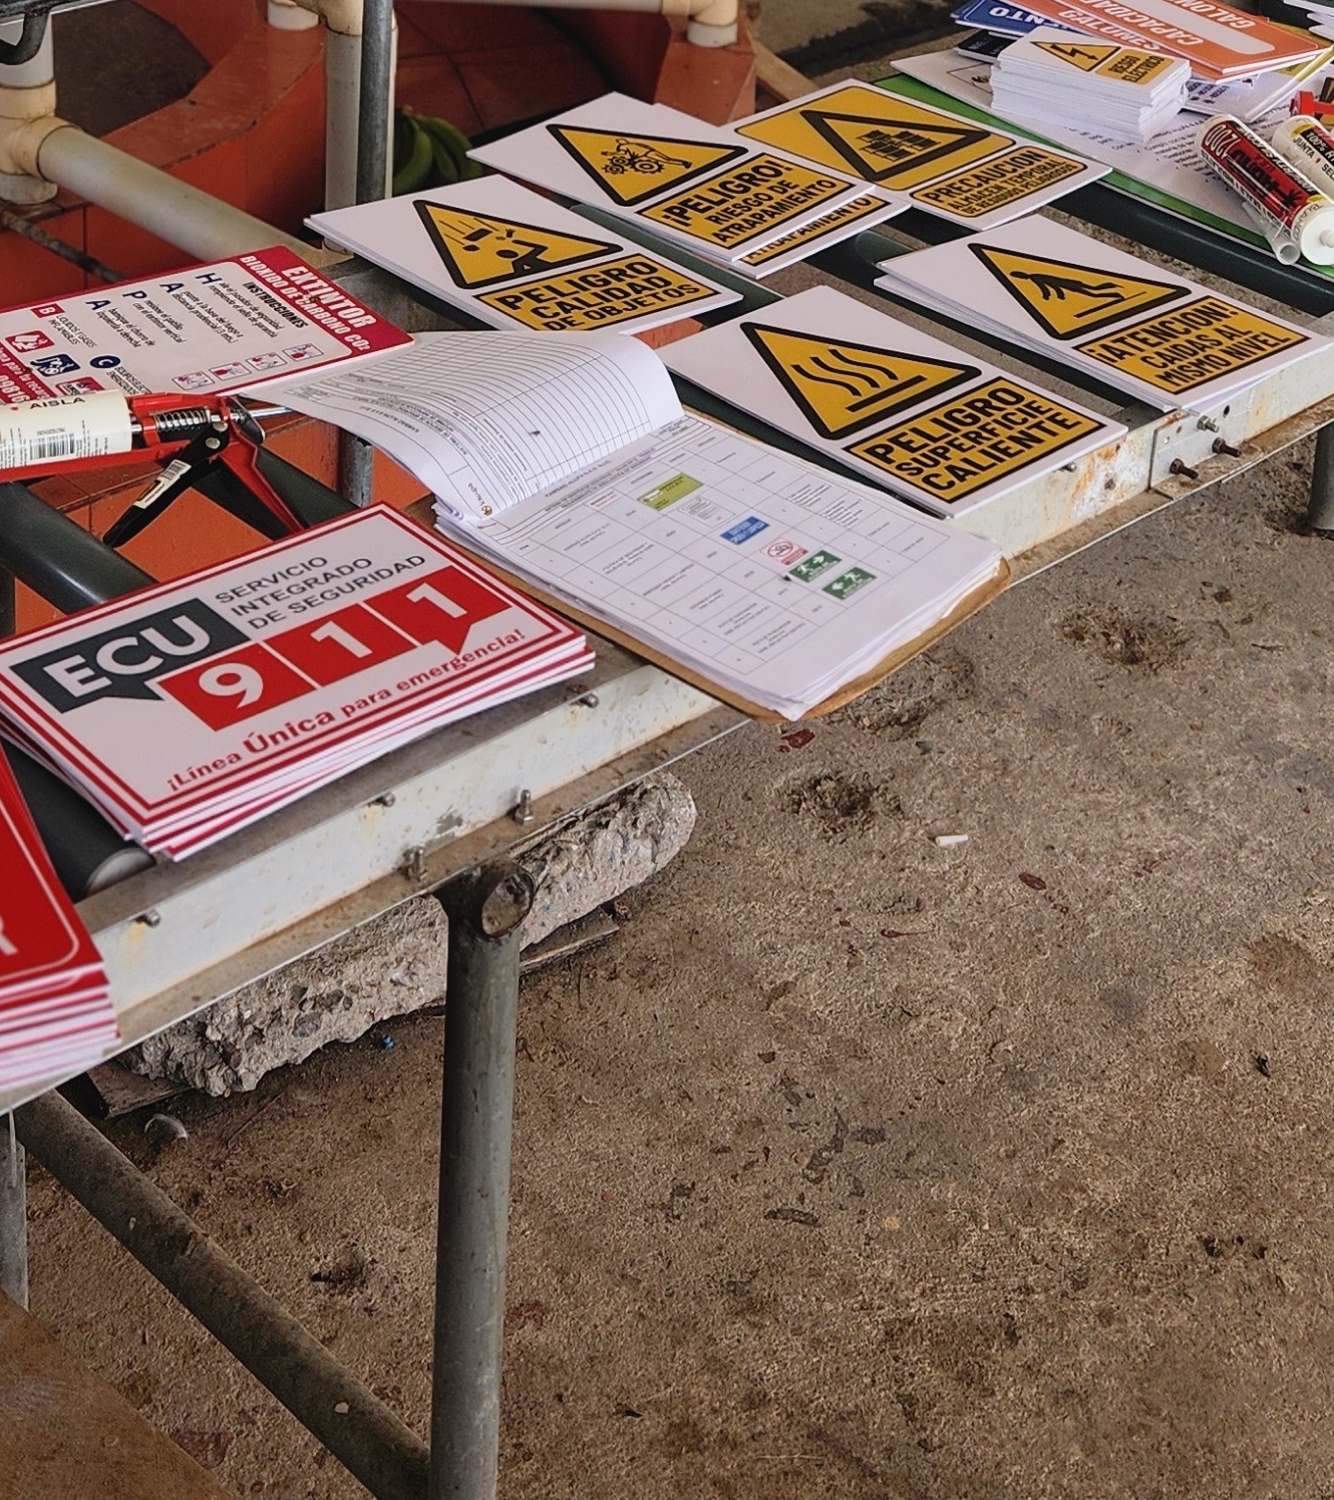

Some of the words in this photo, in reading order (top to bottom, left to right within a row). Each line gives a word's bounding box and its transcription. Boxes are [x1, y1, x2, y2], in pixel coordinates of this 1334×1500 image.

[1204, 124, 1242, 160] 1200
[1293, 137, 1314, 159] JUNTA
[1305, 131, 1327, 152] 100%
[661, 160, 794, 227] ¡PELIGRO!
[705, 192, 771, 226] RIESGO
[772, 179, 800, 196] DE
[922, 150, 1050, 203] PRECAUCION
[946, 183, 1005, 211] ALMACEN
[1002, 159, 1067, 189] TEMPORAL
[711, 179, 837, 243] ATRAPAMIENTO
[37, 306, 57, 314] B
[240, 255, 289, 289] BIOXIDO
[280, 286, 302, 301] DE
[297, 295, 351, 335] CARBONO
[242, 282, 309, 329] INSTRUCCIONES
[281, 266, 377, 328] EXTINTOR
[494, 261, 659, 310] PELIGRO
[530, 276, 672, 319] CALIDAD
[541, 316, 585, 331] DE
[583, 284, 700, 321] OBJETOS
[1086, 302, 1240, 364] ¡ATENCION!
[1140, 333, 1221, 370] CAIDAS
[1214, 324, 1253, 342] AL
[1155, 353, 1234, 387] MISMO
[1221, 331, 1293, 361] NIVEL
[1, 361, 30, 375] para
[30, 396, 86, 410] AISLA
[863, 387, 1026, 464] PELIGRO
[895, 400, 1053, 477] SUPERFICIE
[921, 411, 1083, 492] CALIENTE
[216, 556, 330, 605] SERVICIO
[230, 557, 373, 617] INTEGRADO
[247, 610, 276, 631] DE
[280, 555, 427, 619] SEGURIDAD
[43, 614, 212, 699] ECU
[166, 751, 243, 792] ¡Línea
[243, 707, 336, 756] Única
[340, 686, 392, 719] para
[396, 628, 527, 694] emergencia!
